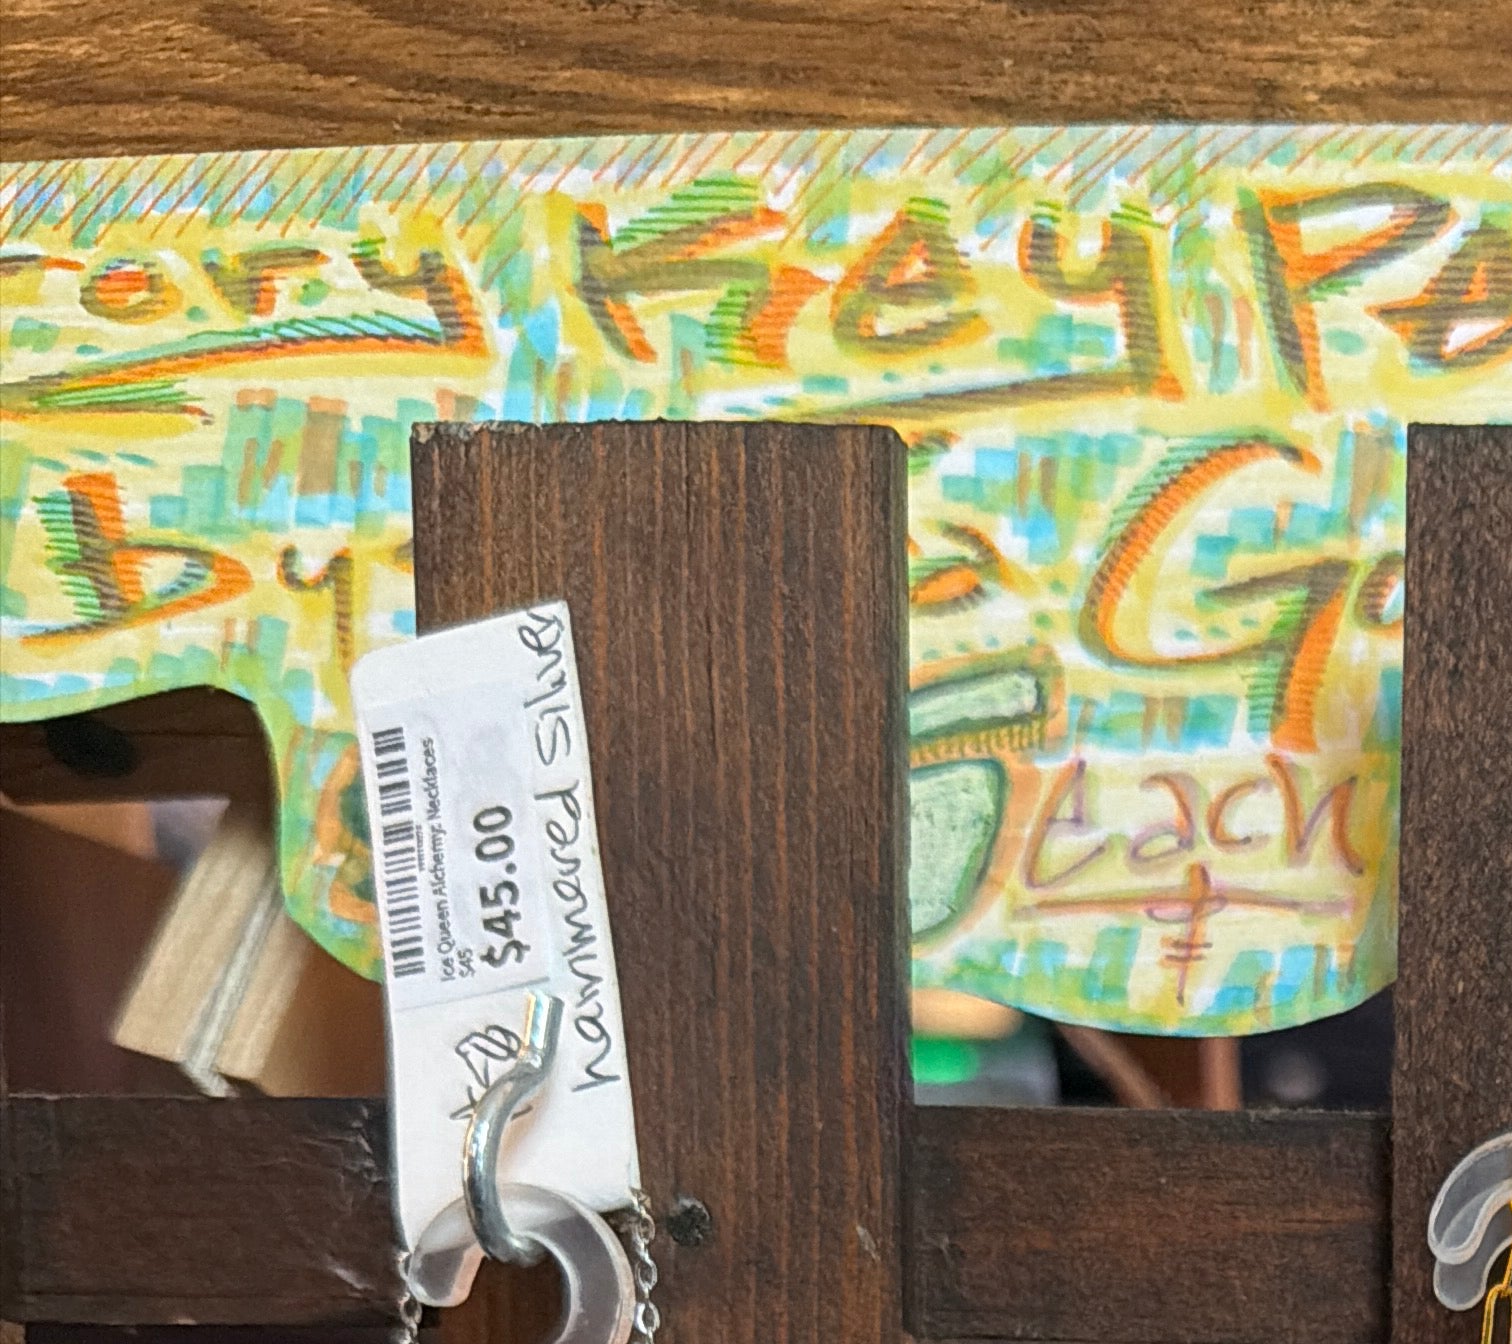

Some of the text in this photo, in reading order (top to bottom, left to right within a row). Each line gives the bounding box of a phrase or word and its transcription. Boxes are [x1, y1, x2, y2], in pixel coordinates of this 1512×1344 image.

[24, 472, 354, 672] by
[421, 737, 455, 982] Ice Queen Alchemy: Necklaces
[472, 804, 531, 969] $45.00
[458, 948, 475, 978] $45
